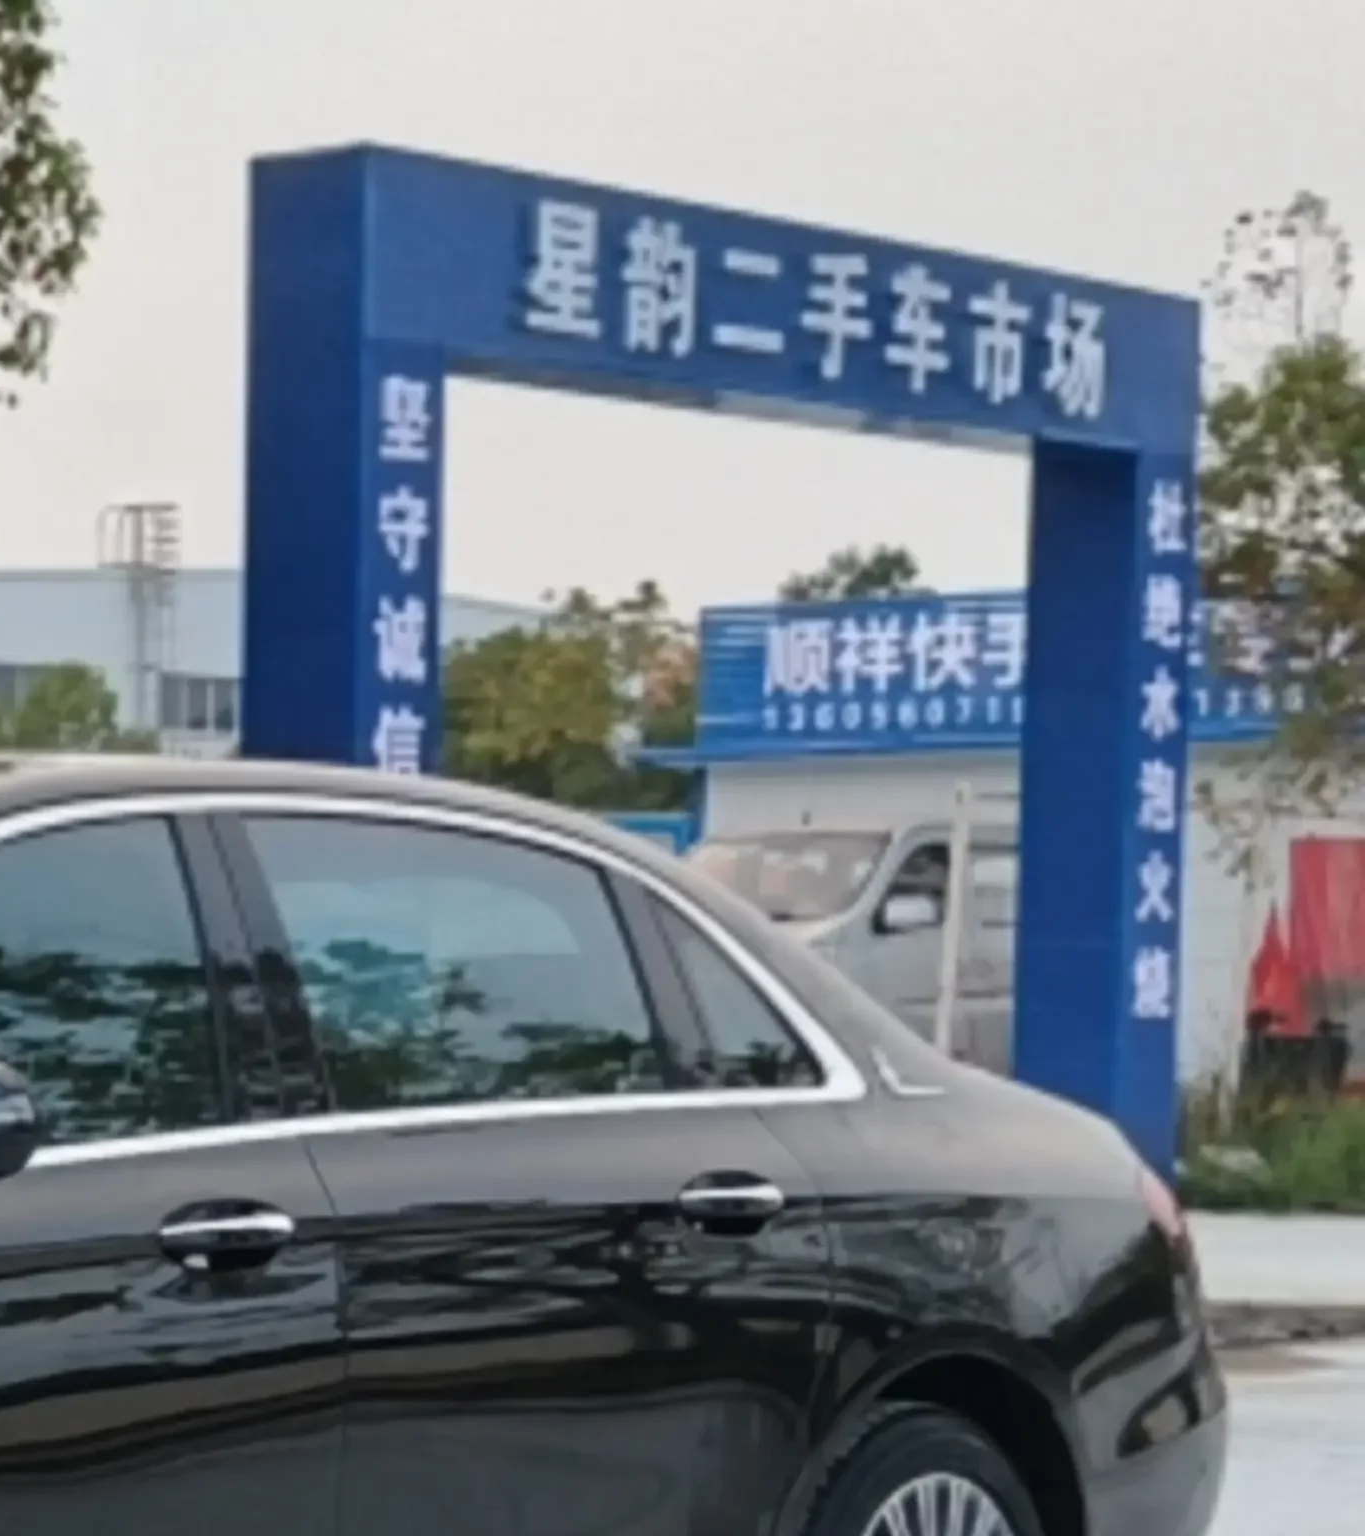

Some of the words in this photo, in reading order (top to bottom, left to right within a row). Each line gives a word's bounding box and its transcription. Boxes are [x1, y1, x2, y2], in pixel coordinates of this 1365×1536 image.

[526, 200, 1106, 418] 星韵二手车市场
[373, 374, 432, 774] 坚守诚信
[1132, 479, 1187, 1018] 杜绝水泡火烧
